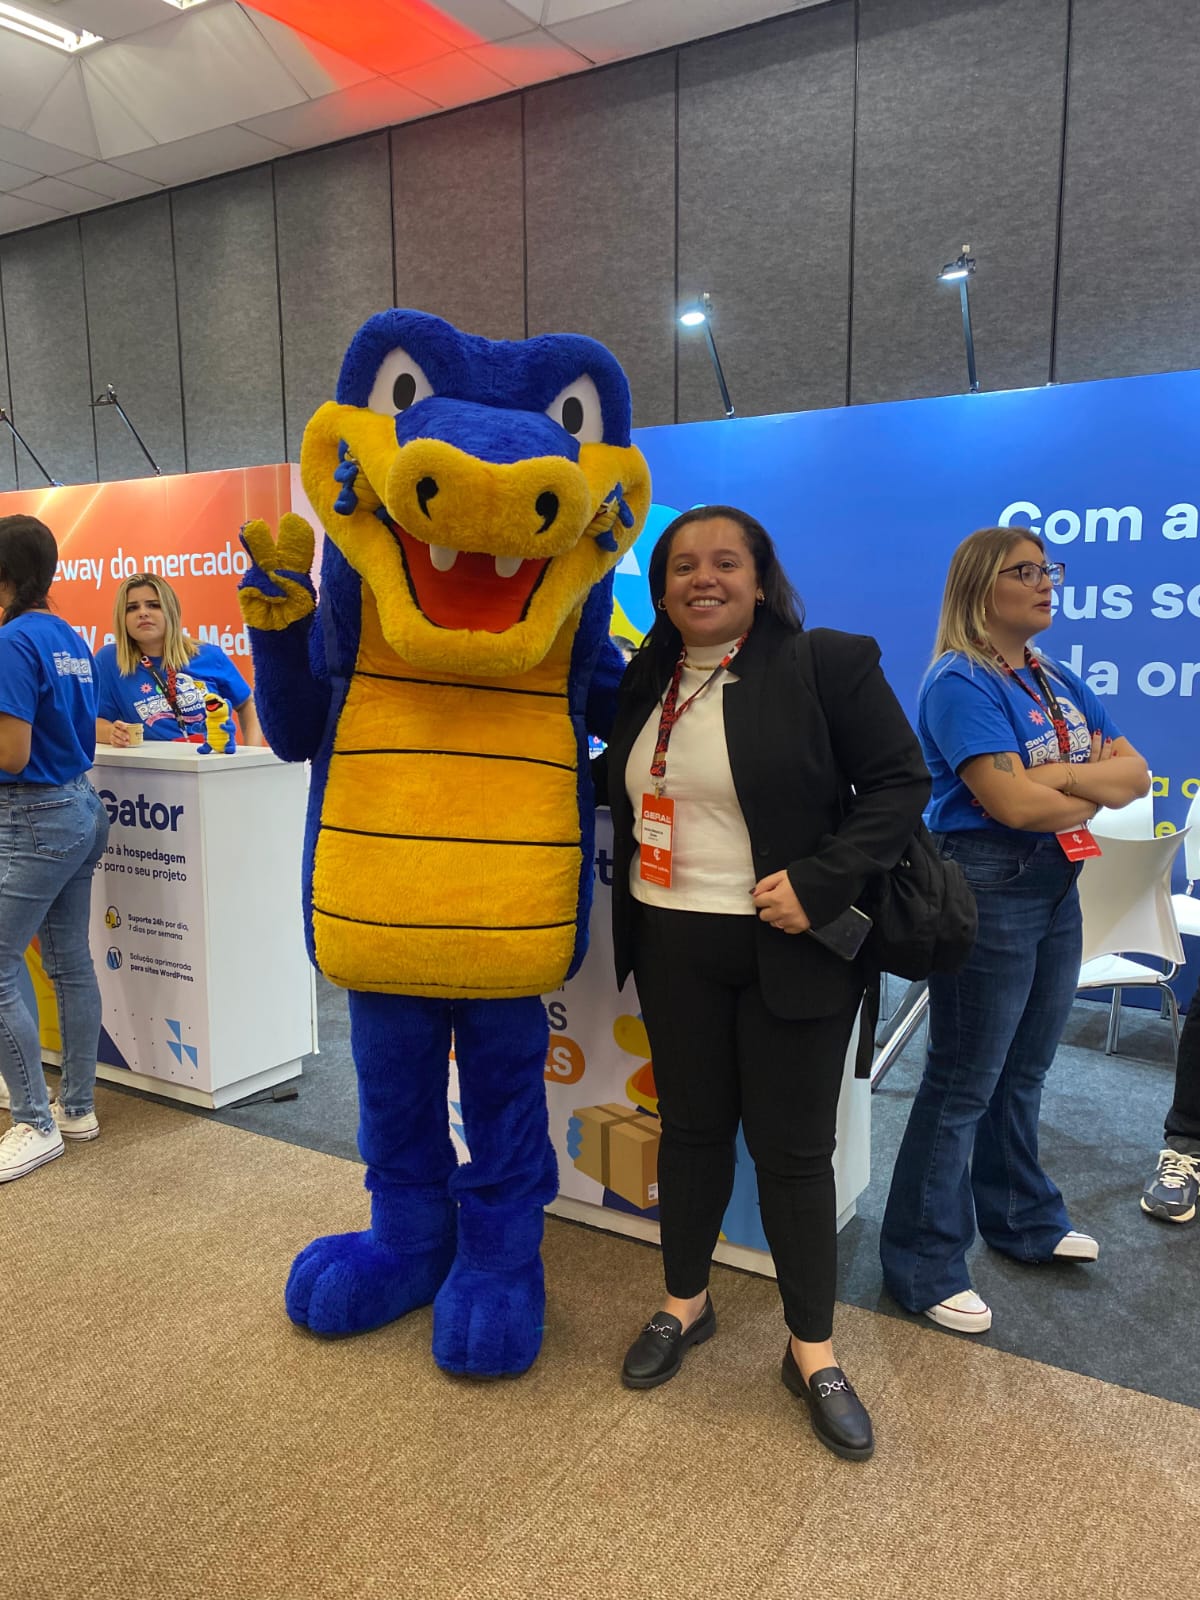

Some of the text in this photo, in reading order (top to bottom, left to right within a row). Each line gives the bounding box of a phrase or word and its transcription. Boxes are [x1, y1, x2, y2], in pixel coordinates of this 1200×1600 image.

[998, 501, 1143, 545] Com
[111, 547, 137, 579] do
[144, 541, 248, 577] mercado
[1051, 583, 1133, 620] us
[98, 789, 184, 832] Gator
[123, 844, 186, 866] hospedagem
[104, 862, 125, 872] para
[127, 865, 133, 874] o
[135, 867, 151, 877] seu
[153, 869, 187, 882] projeto
[128, 913, 152, 925] Suporte
[152, 918, 165, 926] 24h
[165, 921, 176, 929] por
[132, 925, 146, 933] dias
[158, 930, 183, 940] semana
[130, 952, 192, 971] Solução aprimorada
[130, 964, 194, 982] para sites WordPress
